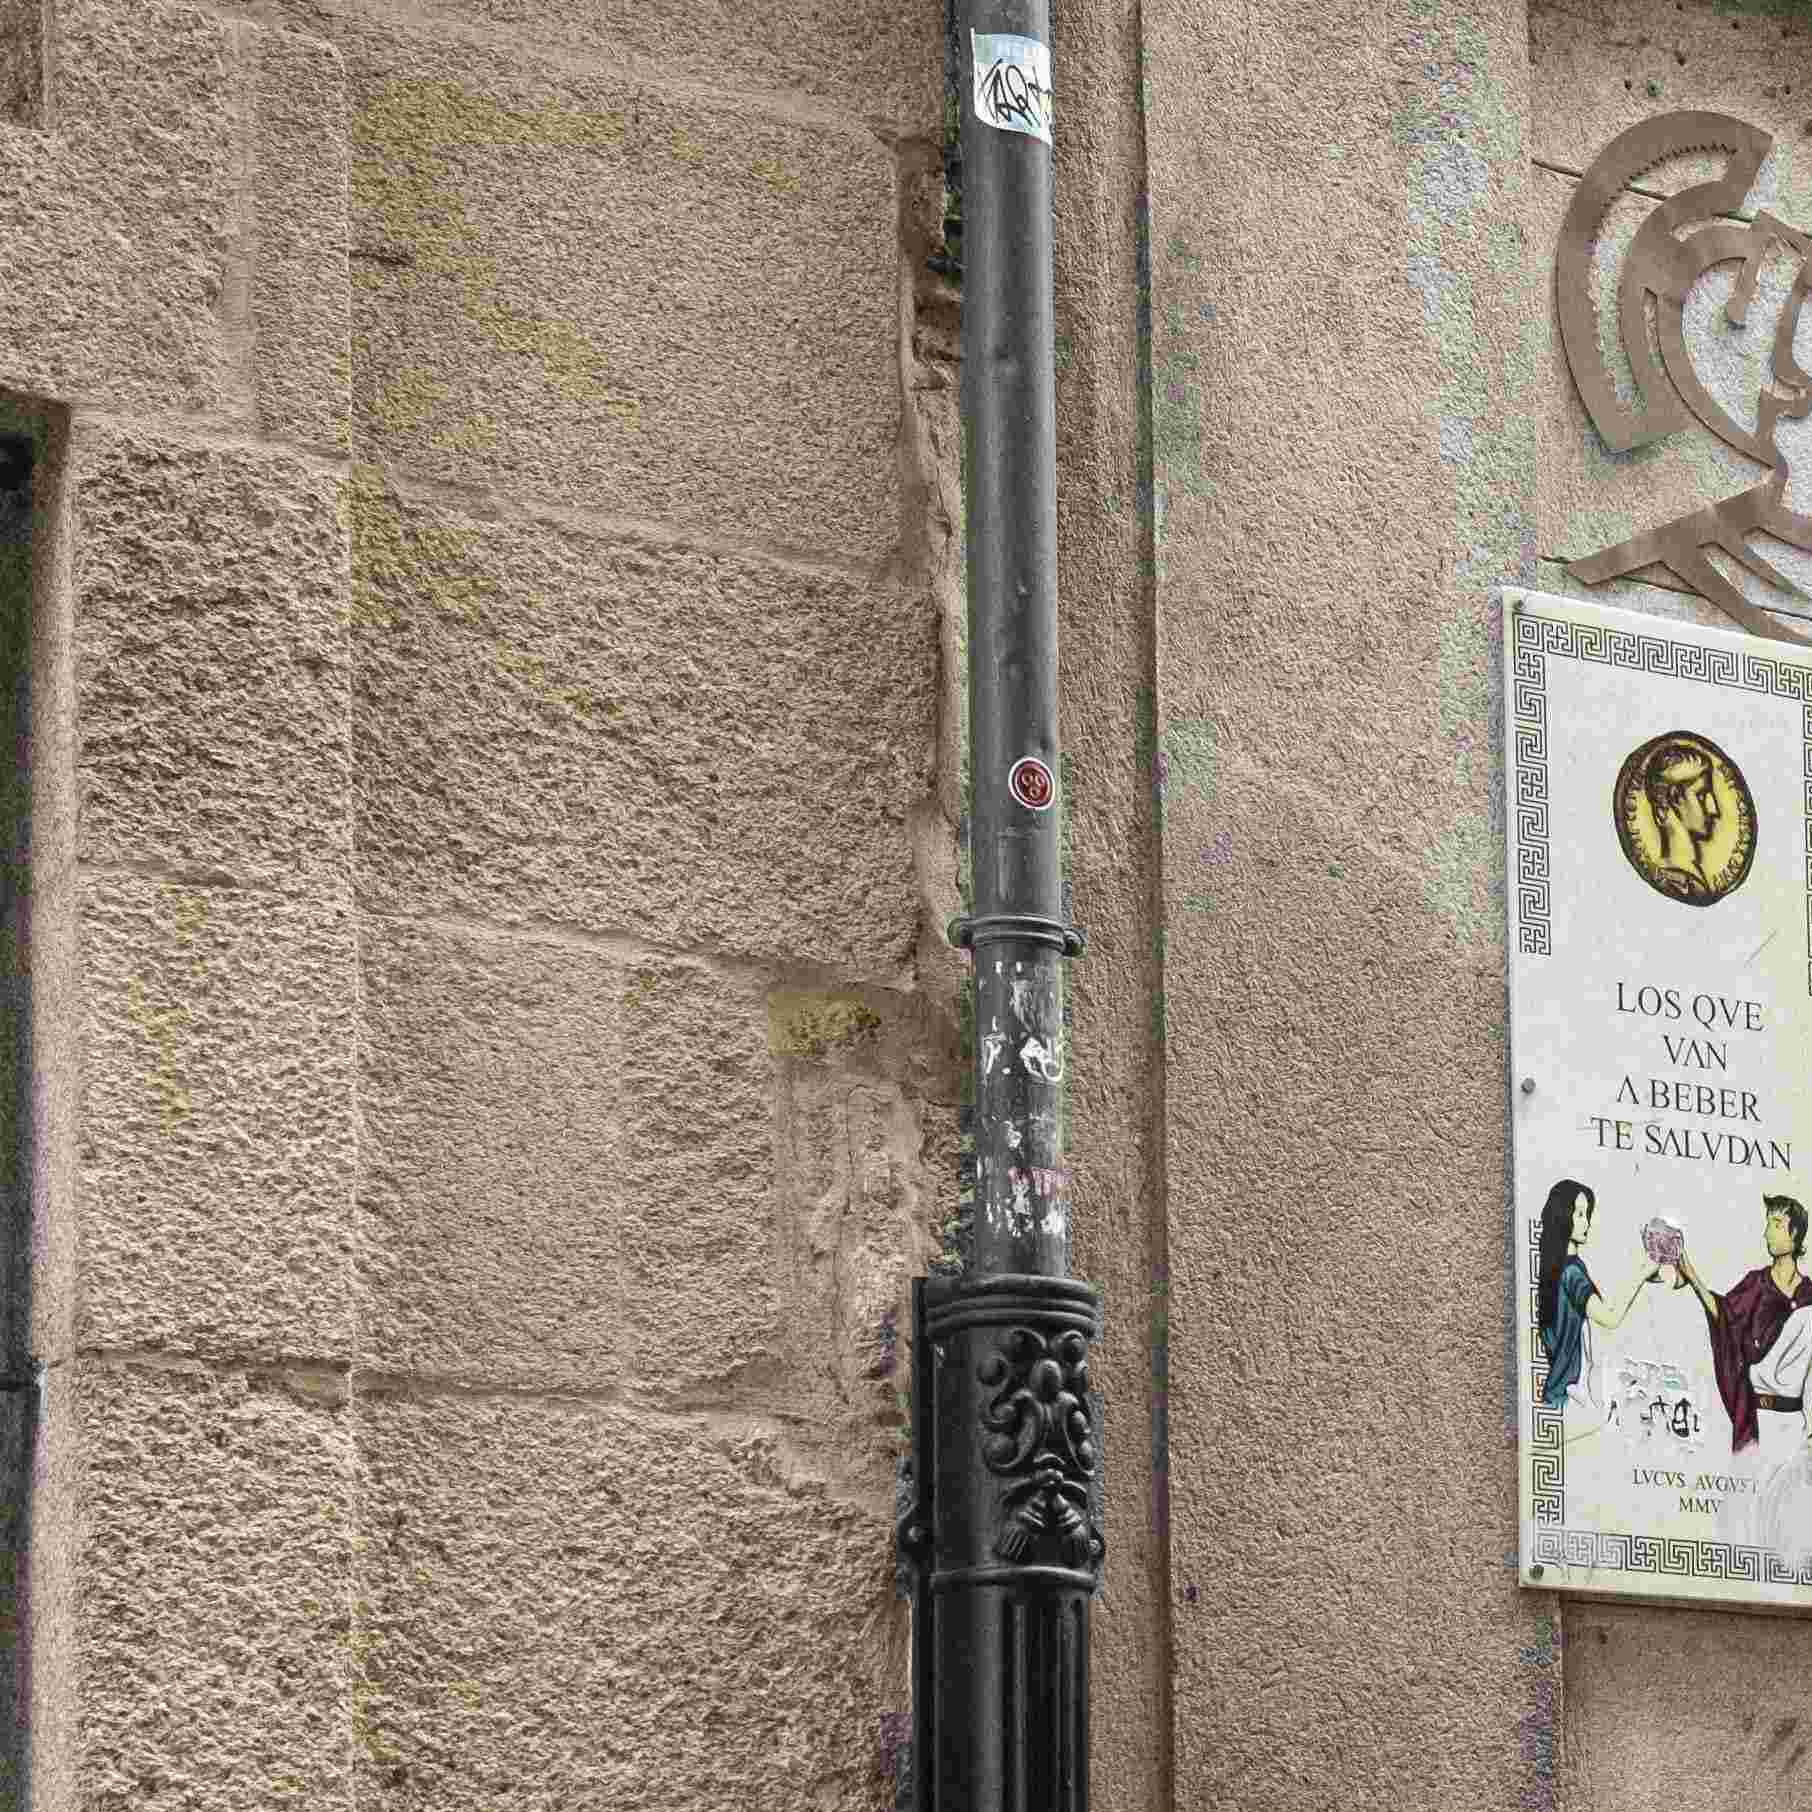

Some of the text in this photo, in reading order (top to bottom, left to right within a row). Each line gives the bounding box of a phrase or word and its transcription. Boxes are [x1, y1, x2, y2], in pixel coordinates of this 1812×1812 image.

[1615, 981, 1764, 1032] LOS QVE
[1663, 1034, 1728, 1071] VAN
[1616, 1074, 1761, 1123] A BEBER
[1590, 1117, 1792, 1171] TE SALVDAN
[1632, 1467, 1686, 1489] LVCVS
[1679, 1495, 1723, 1514] MMV
